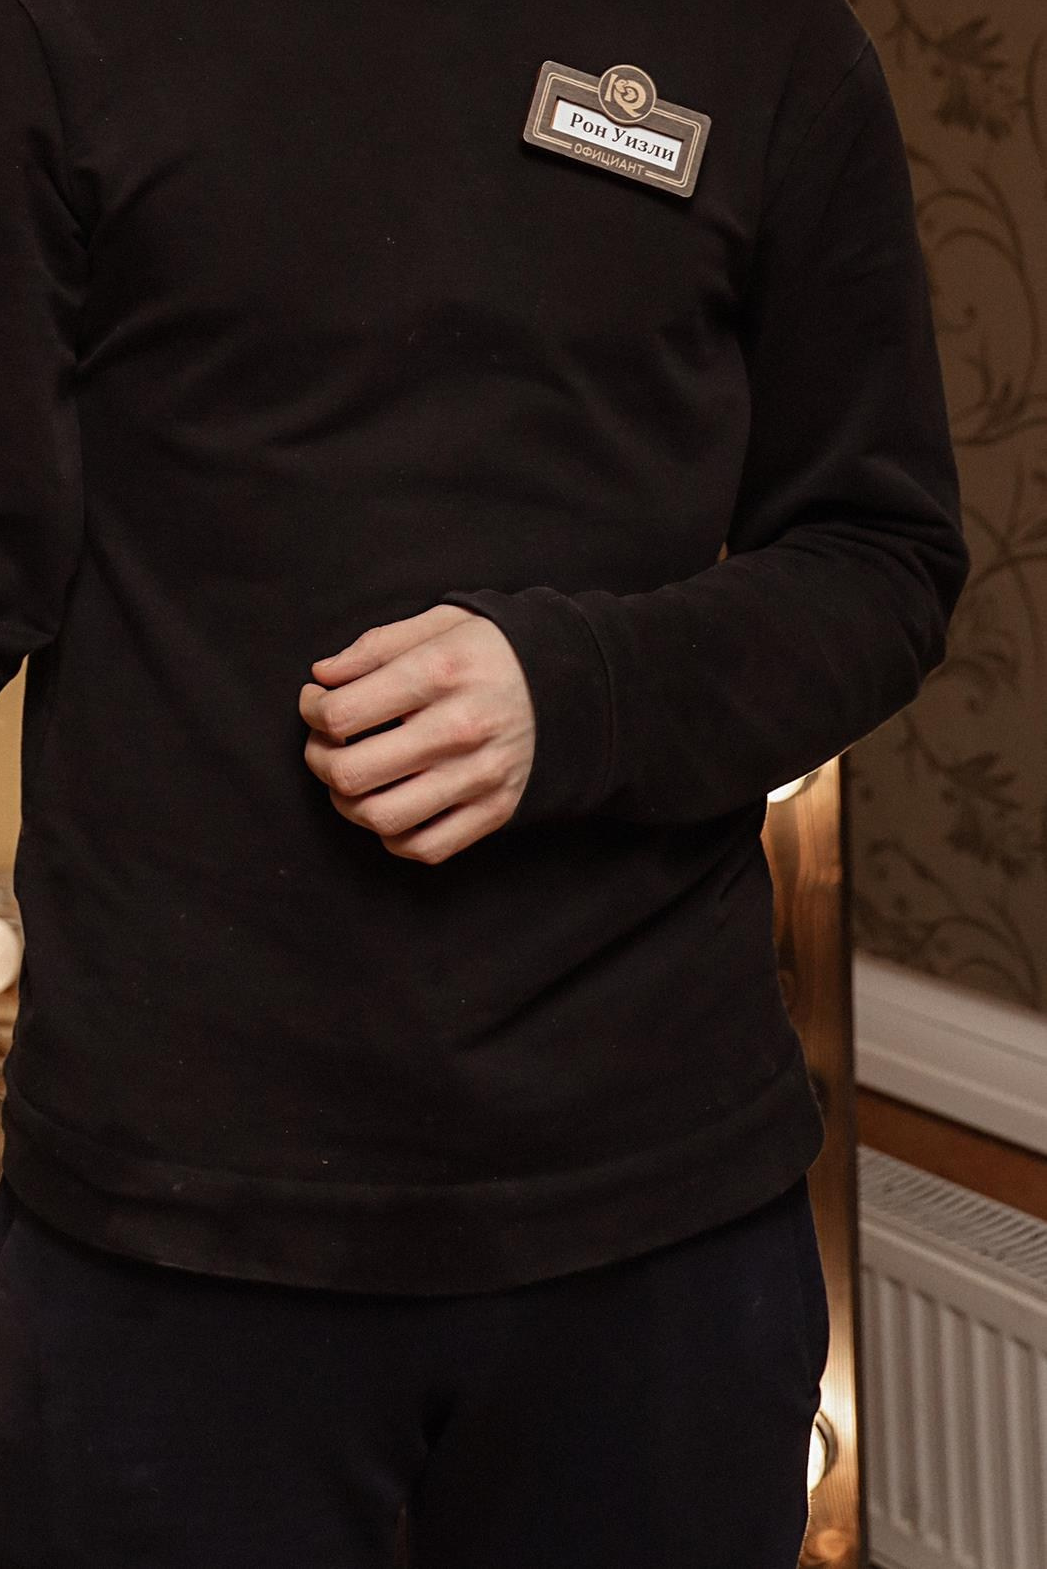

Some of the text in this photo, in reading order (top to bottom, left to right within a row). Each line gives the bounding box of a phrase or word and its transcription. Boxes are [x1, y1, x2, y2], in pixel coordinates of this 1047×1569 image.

[570, 112, 675, 162] Рон Уизли
[574, 142, 645, 176] ОФИЦИАНТ
